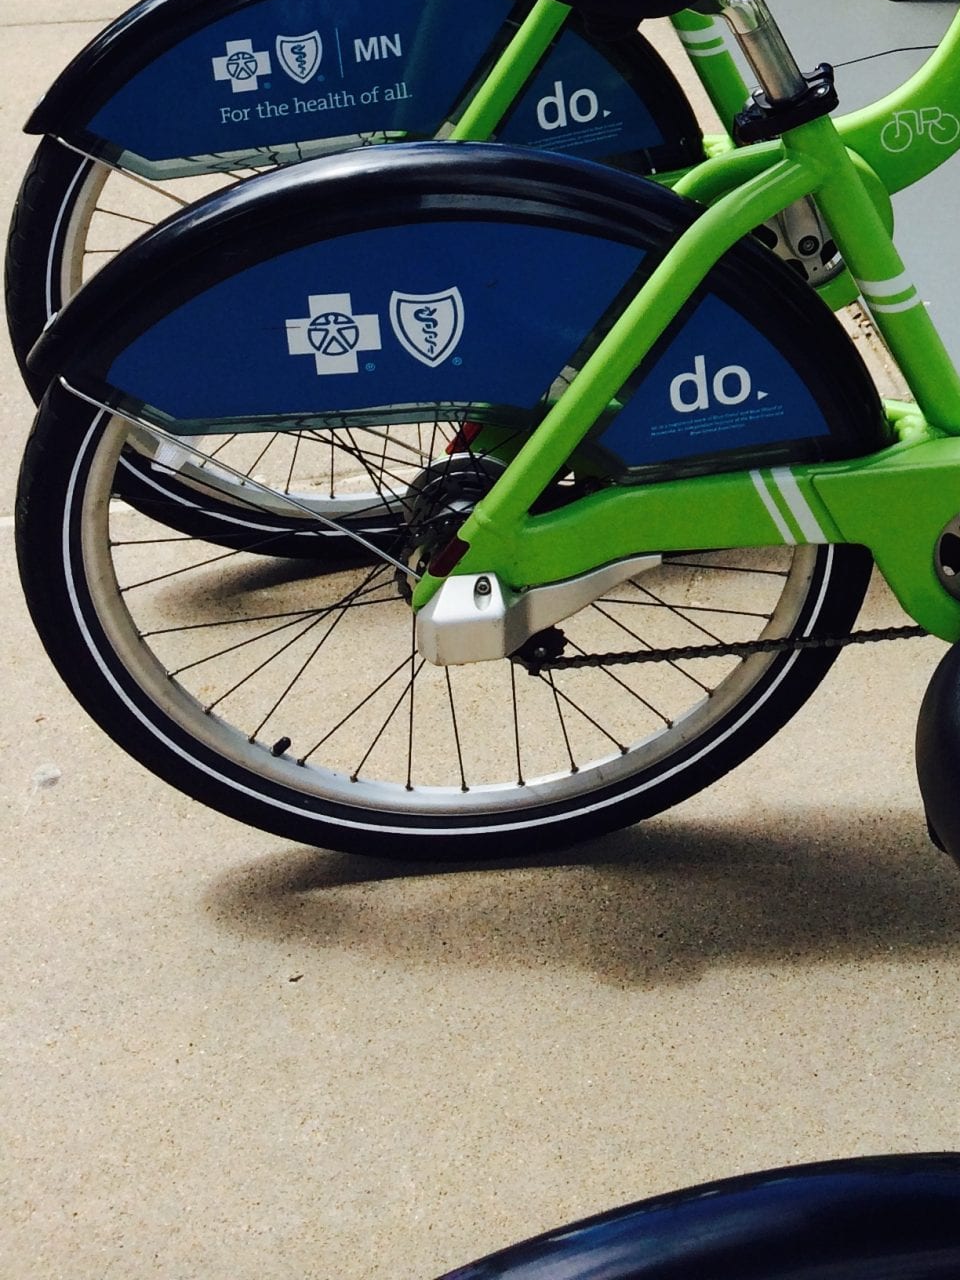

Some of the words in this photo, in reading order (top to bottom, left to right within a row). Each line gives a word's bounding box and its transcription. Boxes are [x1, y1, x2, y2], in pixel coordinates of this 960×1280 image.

[354, 33, 402, 63] MN
[220, 107, 251, 124] For
[256, 101, 289, 119] the
[293, 90, 355, 115] health
[360, 86, 380, 105] of
[384, 81, 413, 100] all.
[537, 80, 612, 131] do.
[669, 354, 769, 413] do.
